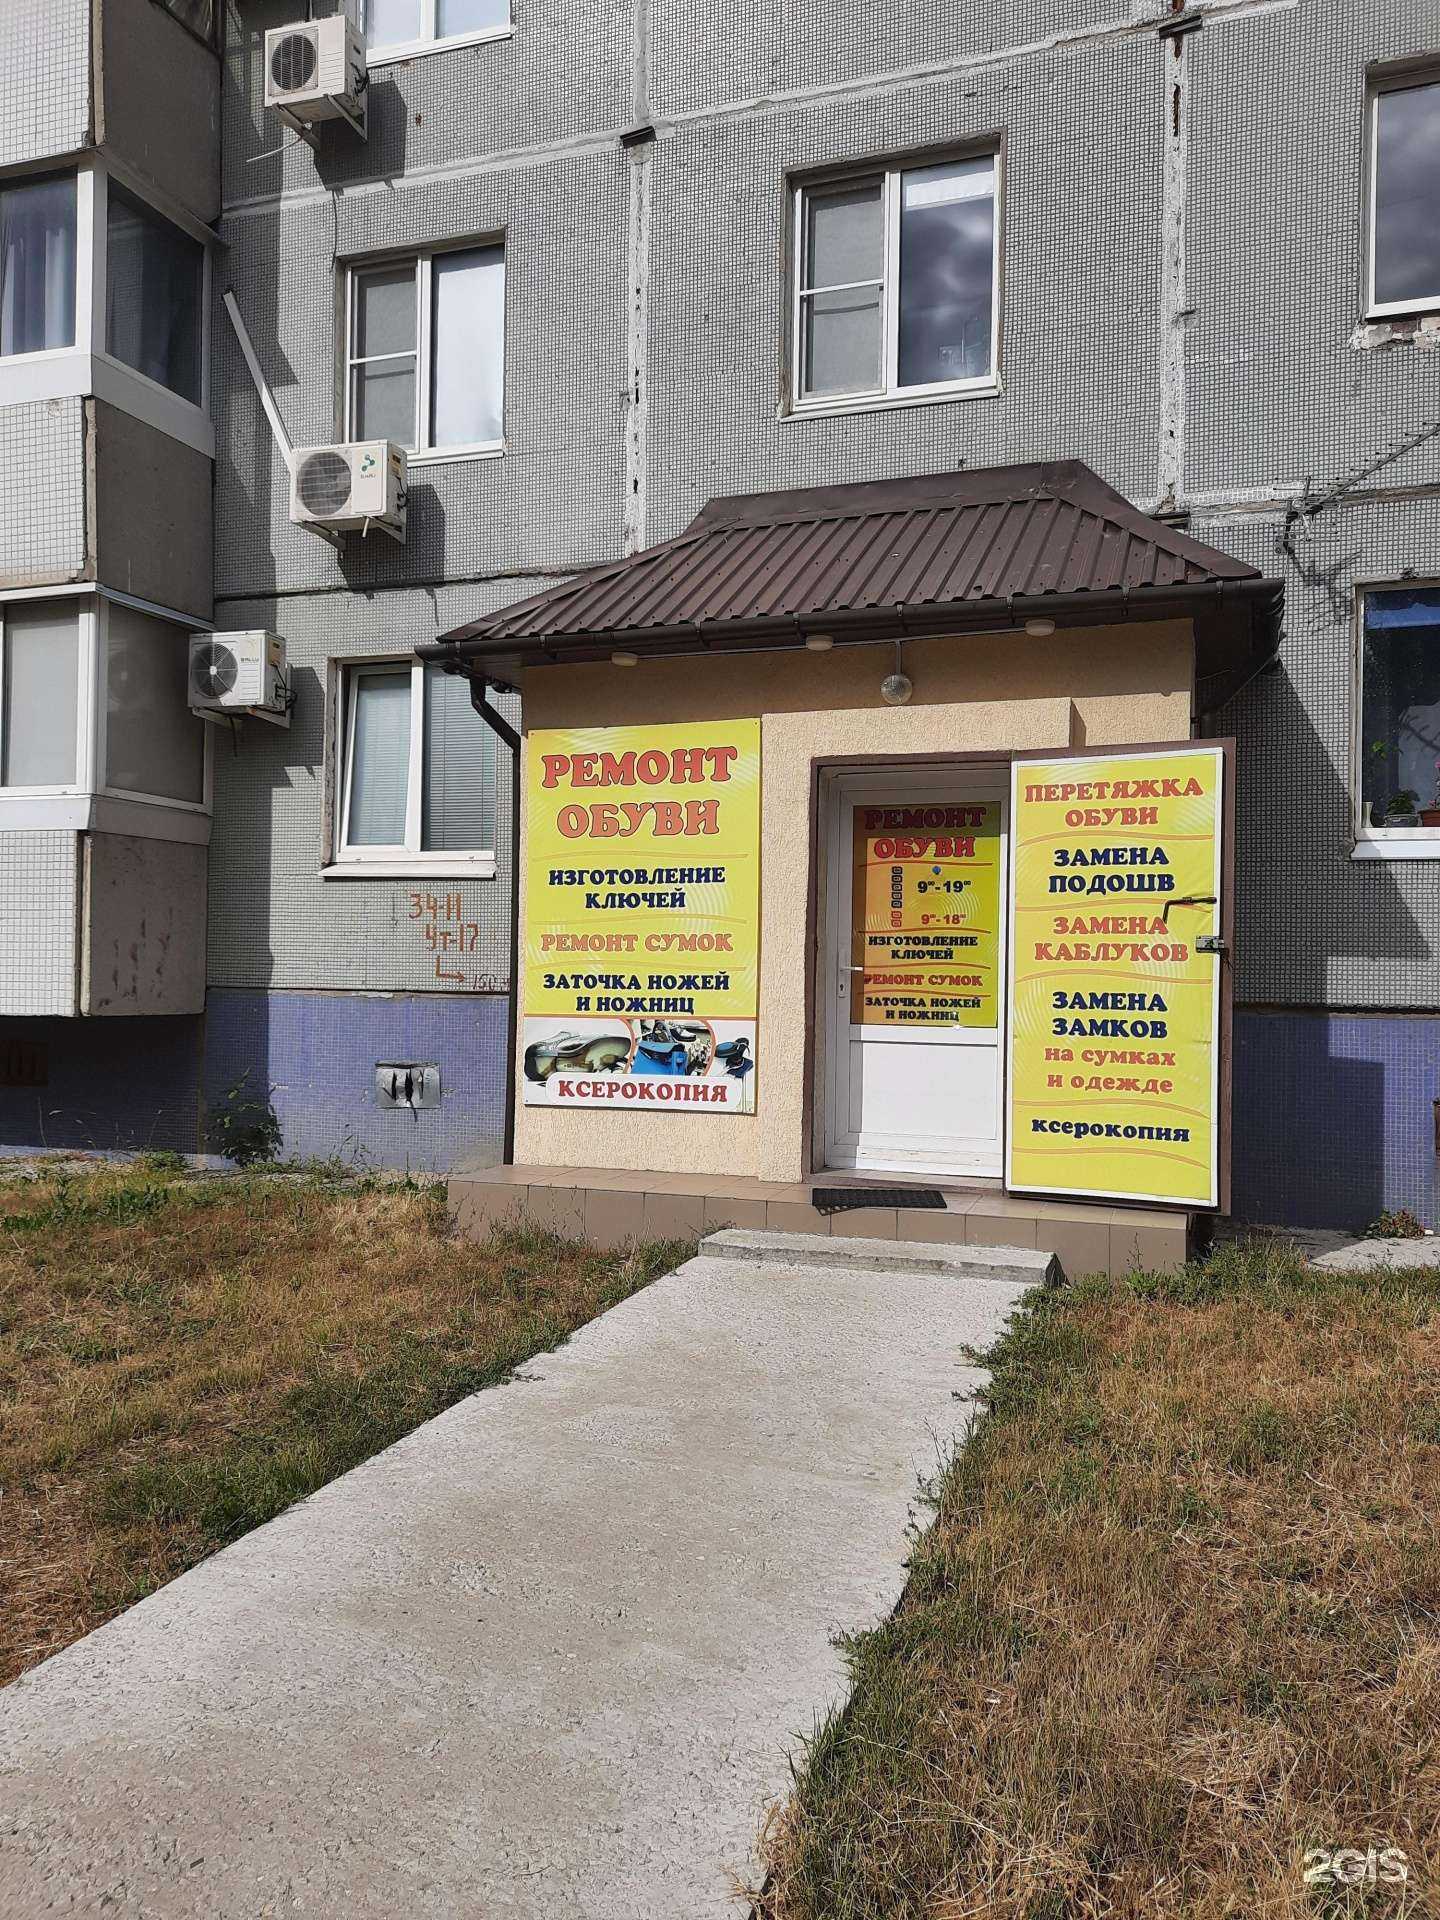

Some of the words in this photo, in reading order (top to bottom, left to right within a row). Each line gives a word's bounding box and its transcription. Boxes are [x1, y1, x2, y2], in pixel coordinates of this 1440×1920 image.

[541, 745, 737, 788] РЕМОНТ
[1024, 776, 1204, 803] ПЕРЕТЯЖКА
[556, 799, 720, 838] ОБУВИ
[864, 807, 986, 830] РЕМОНТ
[1065, 807, 1159, 827] ОБУВИ
[874, 837, 975, 858] ОБУВИ
[1053, 846, 1170, 867] ЗАМЕНА
[548, 867, 725, 886] ИЗГОТОВЛЕНИЕ
[1049, 873, 1176, 895] ПОДОШВ
[585, 887, 686, 909] КЛЮЧЕЙ
[1053, 916, 1168, 935] ЗАМЕНА
[541, 934, 639, 952] РЕМОНТ
[644, 933, 734, 952] СУМОК
[868, 935, 978, 947] ИЗГОТОВЛЕНИЕ
[891, 948, 954, 960] КЛЮЧЕЙ
[1034, 943, 1189, 963] КАБЛУКОВ
[543, 973, 641, 991] ЗАТОЧКА
[648, 970, 730, 991] НОЖЕЙ
[864, 974, 925, 986] РЕМОНТ
[928, 974, 984, 987] СУМОК
[576, 996, 591, 1012] И
[596, 996, 694, 1015] НОЖНИЦ
[865, 997, 927, 1008] ЗАТОЧКА
[930, 996, 981, 1009] НОЖЕЙ
[1052, 991, 1168, 1012] ЗАМЕНА
[886, 1010, 895, 1020] И
[898, 1010, 960, 1022] НОЖНИЦ
[1051, 1018, 1168, 1039] ЗАМКОВ
[1044, 1047, 1074, 1063] на
[1081, 1049, 1176, 1067] сумках
[558, 1080, 727, 1102] КСЕРОКОПИЯ
[1070, 1074, 1173, 1095] одежде
[1031, 1117, 1190, 1143] ксерокопия
